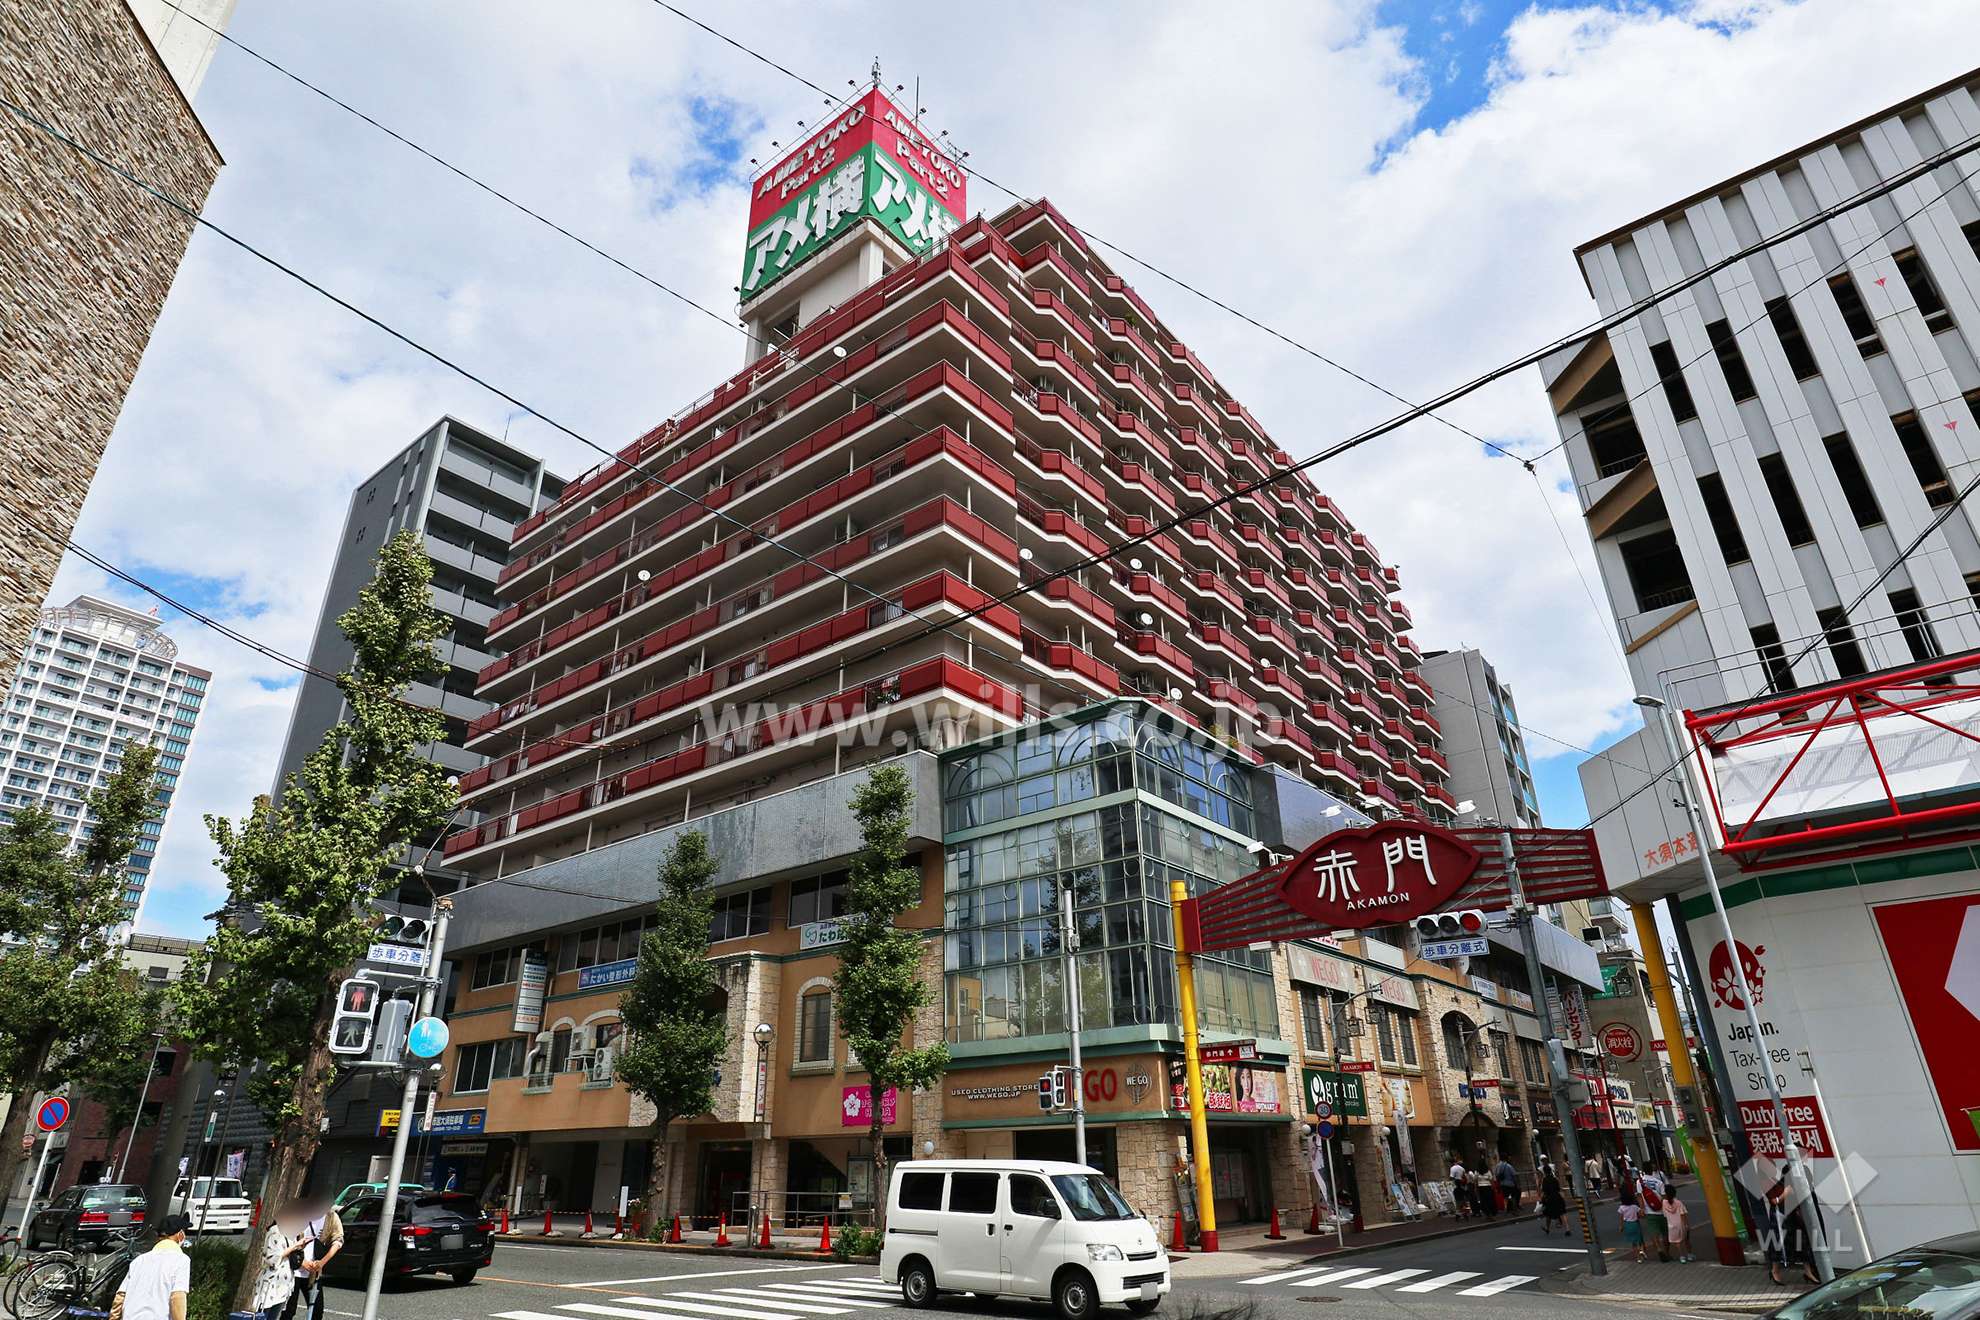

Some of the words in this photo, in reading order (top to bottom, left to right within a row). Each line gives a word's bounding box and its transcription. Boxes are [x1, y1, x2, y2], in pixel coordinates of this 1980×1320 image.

[744, 154, 866, 291] アメ横
[1312, 834, 1438, 903] 赤門
[1346, 892, 1411, 912] AKAMON
[1423, 941, 1487, 956] 歩車分離式
[1311, 956, 1340, 985] WEGO
[1728, 1020, 1780, 1042] Japn.
[1606, 1036, 1633, 1049] 消火栓
[1729, 1047, 1791, 1068] Tax-ee
[972, 1085, 1011, 1095] CLOTHING
[1747, 1072, 1788, 1092] Shp
